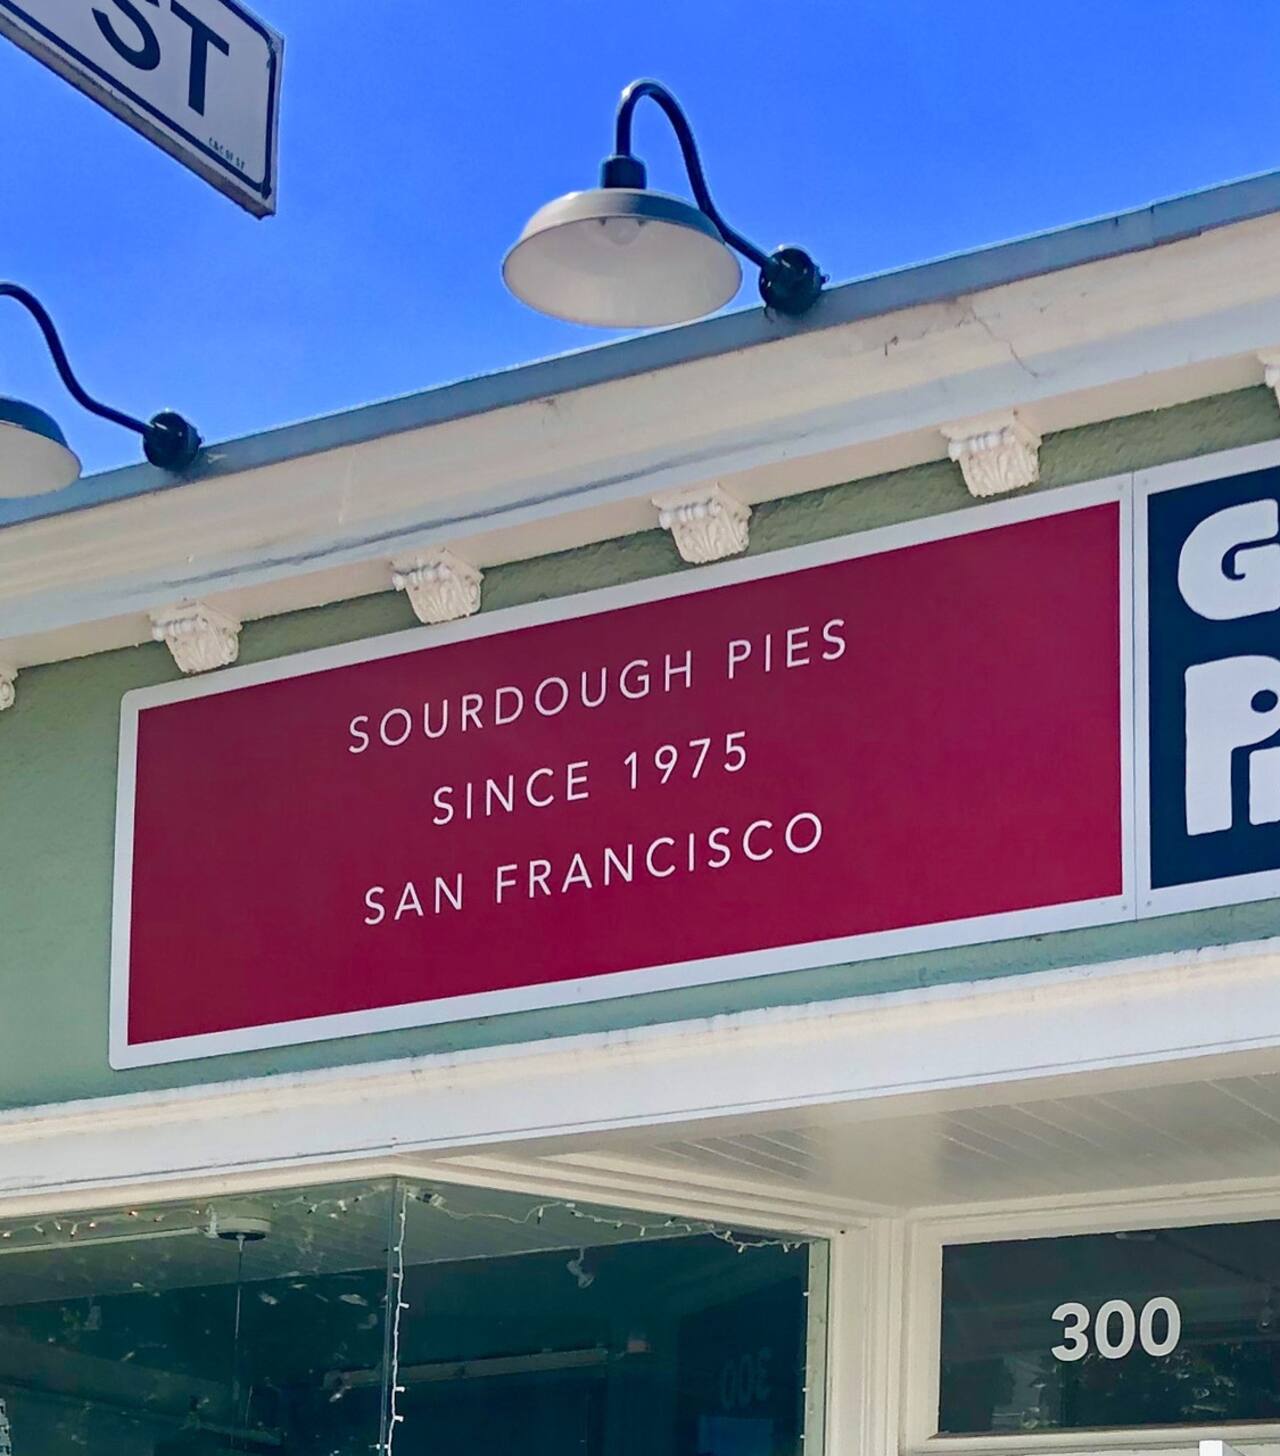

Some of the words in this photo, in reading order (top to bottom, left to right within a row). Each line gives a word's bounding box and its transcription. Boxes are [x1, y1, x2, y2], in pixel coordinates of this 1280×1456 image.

[91, 0, 230, 117] ST
[348, 650, 693, 754] SOURDOUGH
[726, 618, 848, 680] PIES
[432, 761, 590, 826] SINCE
[623, 730, 748, 790] 1975
[363, 873, 464, 927] SAN
[495, 812, 823, 905] FRANCISCO
[1050, 1296, 1183, 1362] 300
